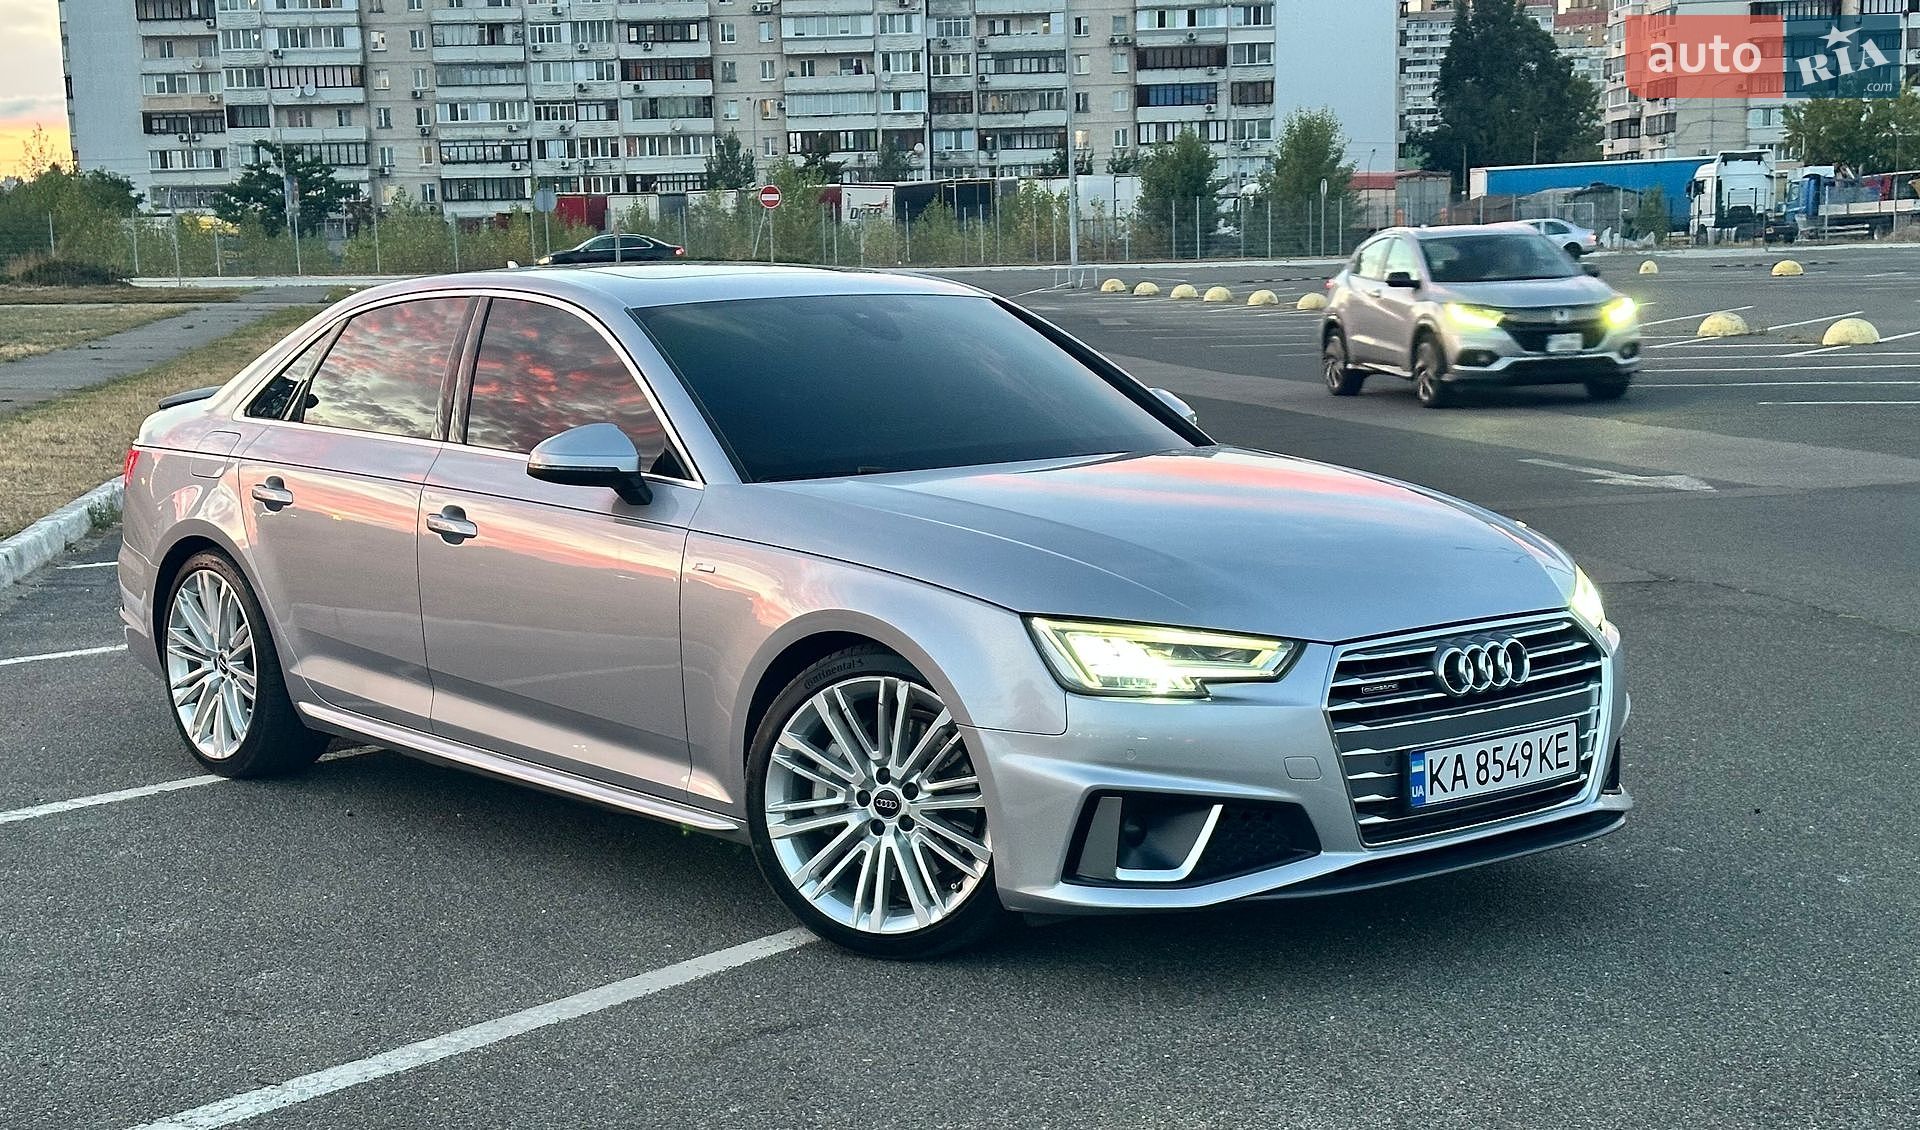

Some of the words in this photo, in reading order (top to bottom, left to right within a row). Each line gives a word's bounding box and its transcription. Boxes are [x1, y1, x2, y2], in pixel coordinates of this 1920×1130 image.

[1429, 753, 1469, 796] KA
[1475, 740, 1534, 786] 8549
[1538, 731, 1570, 774] KE
[1411, 785, 1425, 798] UA
